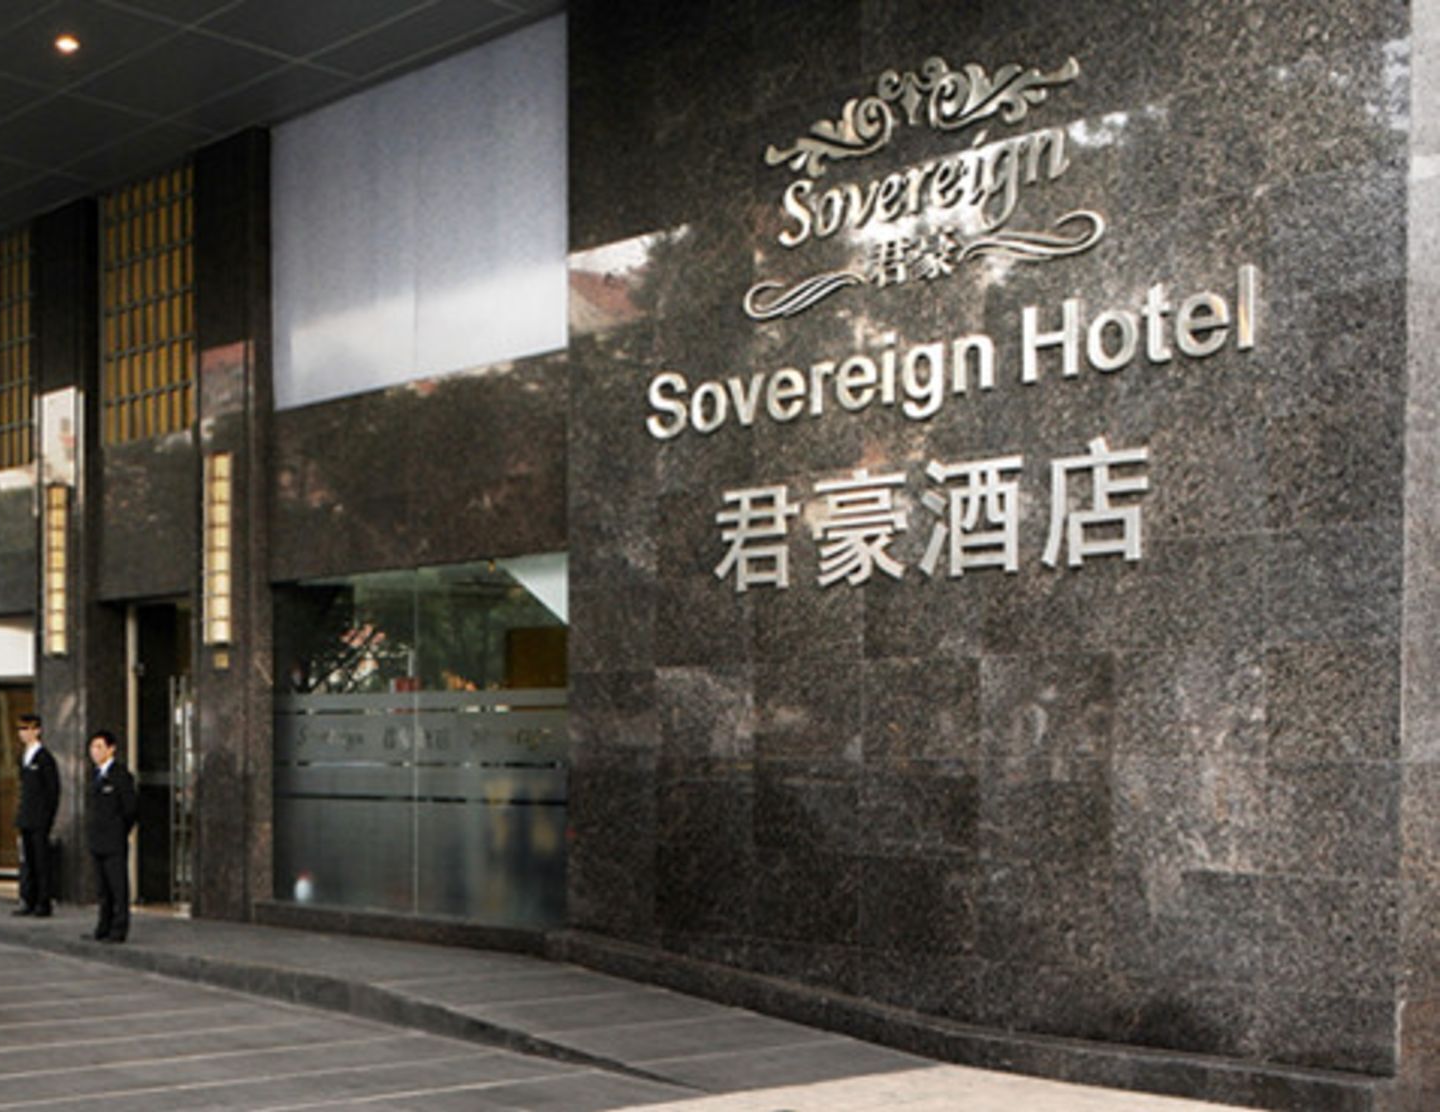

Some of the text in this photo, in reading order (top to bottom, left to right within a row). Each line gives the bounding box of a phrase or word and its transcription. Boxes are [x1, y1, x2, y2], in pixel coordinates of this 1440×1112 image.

[778, 127, 1071, 248] Sovereign
[867, 225, 959, 288] 君豪
[646, 263, 1258, 440] Sovereign Hotel
[713, 436, 1152, 593] 君豪酒店
